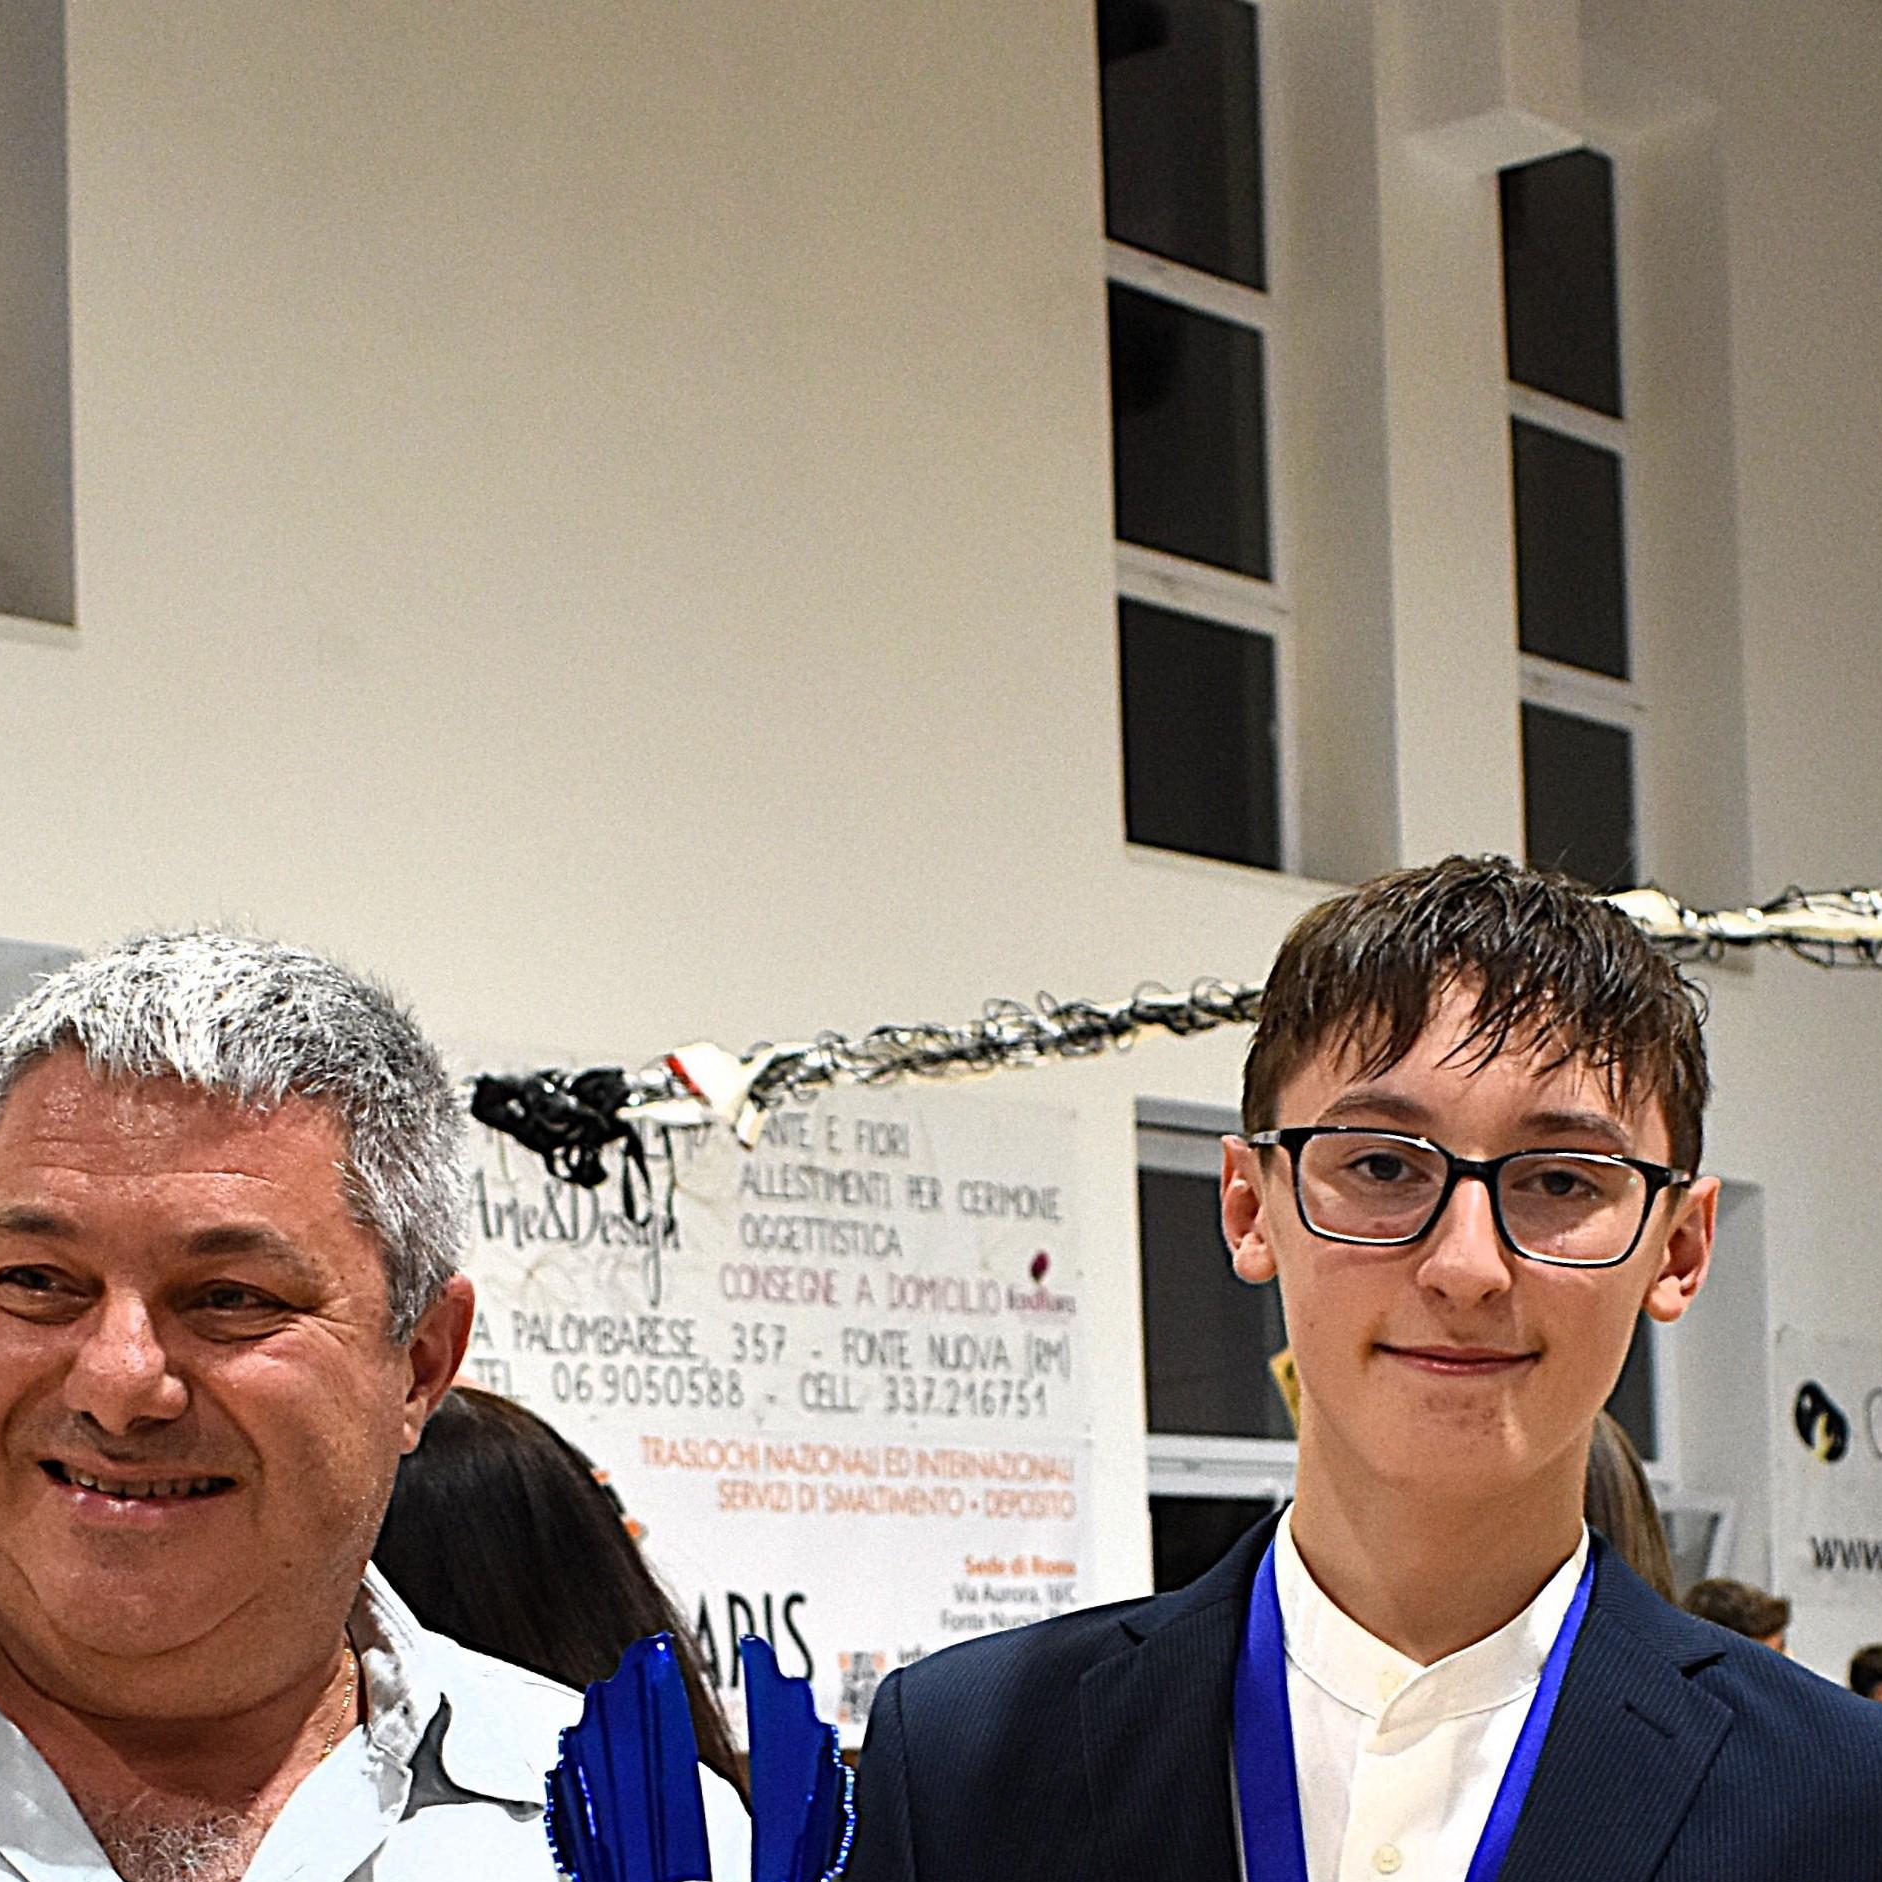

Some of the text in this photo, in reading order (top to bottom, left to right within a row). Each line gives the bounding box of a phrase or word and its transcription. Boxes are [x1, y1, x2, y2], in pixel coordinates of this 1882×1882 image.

[761, 1112, 816, 1150] ANTE
[738, 1162, 892, 1210] ALLESTIMENTI
[906, 1174, 943, 1212] PER
[739, 1213, 903, 1257] OGGETTISTICA
[721, 1262, 840, 1306] CONSEGNE
[855, 1274, 876, 1305] A
[887, 1272, 1001, 1315] DOMICILIO
[731, 1322, 787, 1363] 357
[843, 1327, 912, 1369] FONTE
[928, 1334, 1012, 1372] NUOVA
[640, 1434, 760, 1473] TRASLOCHI
[764, 1440, 879, 1478] NAZIONALI
[719, 1480, 792, 1512] SERVIZI
[824, 1483, 963, 1517] SMALTIMENTO
[983, 1490, 1077, 1520] DEPOSITO
